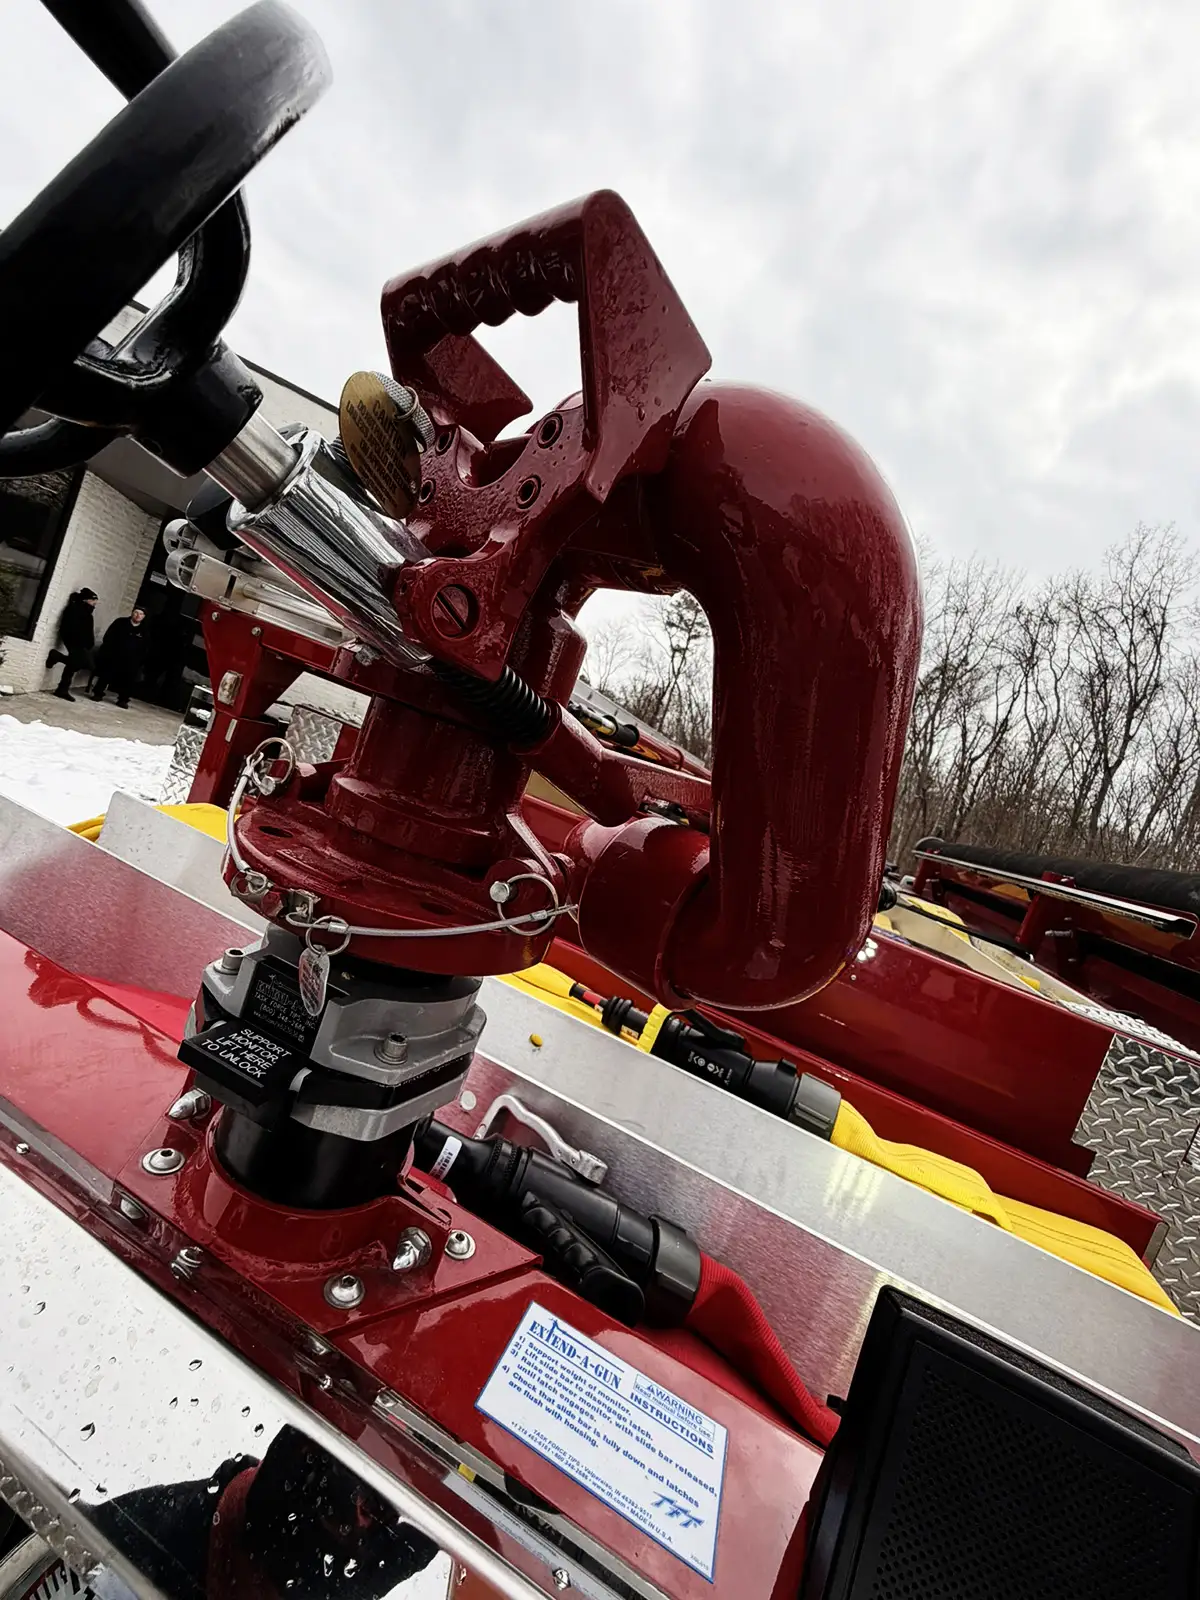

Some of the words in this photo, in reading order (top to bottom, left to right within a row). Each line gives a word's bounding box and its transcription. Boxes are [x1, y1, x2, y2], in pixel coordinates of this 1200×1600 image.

[254, 992, 268, 1001] TASK
[270, 1001, 287, 1013] FORCE
[260, 1003, 276, 1016] (800)
[201, 1039, 220, 1051] TO
[219, 1049, 267, 1078] UNLOCK
[216, 1036, 242, 1051] LIFT
[240, 1050, 272, 1070] HERE
[240, 1028, 292, 1057] SUPPORT
[519, 1335, 525, 1343] 1)
[528, 1342, 559, 1366] Support
[560, 1364, 587, 1385] weight
[588, 1383, 597, 1392] of
[529, 1320, 621, 1389] EXTEND-A-GUN
[508, 1380, 522, 1393] are
[523, 1389, 543, 1408] flush
[545, 1405, 563, 1422] with
[564, 1418, 599, 1448] housing.
[514, 1341, 522, 1350] 2)
[525, 1348, 538, 1361] Lift
[540, 1359, 558, 1375] slide
[560, 1373, 574, 1385] bar
[575, 1383, 583, 1392] to
[585, 1389, 627, 1423] disengage
[629, 1420, 653, 1441] latch.
[517, 1364, 536, 1379] until
[537, 1377, 558, 1395] latch
[559, 1393, 597, 1422] engages.
[635, 1384, 651, 1400] Read
[652, 1396, 676, 1414] manual
[677, 1411, 697, 1430] before
[699, 1427, 711, 1438] use
[656, 1389, 703, 1425] WARNING
[501, 1364, 510, 1373] 4)
[512, 1372, 537, 1393] Check
[539, 1390, 555, 1406] that
[556, 1402, 576, 1420] slide
[577, 1417, 592, 1431] bar
[594, 1428, 601, 1438] is
[602, 1434, 621, 1452] fully
[622, 1449, 646, 1470] down
[648, 1467, 664, 1482] and
[666, 1479, 699, 1508] latches
[510, 1348, 518, 1357] 3)
[521, 1356, 543, 1374] Raise
[545, 1372, 553, 1380] or
[555, 1378, 577, 1398] lower
[579, 1396, 612, 1424] monitor,
[615, 1420, 633, 1437] with
[635, 1435, 656, 1453] slide
[658, 1449, 673, 1464] bar
[675, 1463, 717, 1498] released,
[630, 1392, 714, 1454] INSTRUCTIONS
[533, 1429, 548, 1442] TASK
[548, 1440, 567, 1457] FORCE
[568, 1455, 580, 1466] TIPS
[584, 1466, 613, 1492] Valparaiso,
[614, 1488, 621, 1496] IN
[554, 1452, 565, 1462] 800
[630, 1508, 648, 1525] MADE
[648, 1521, 655, 1529] IN
